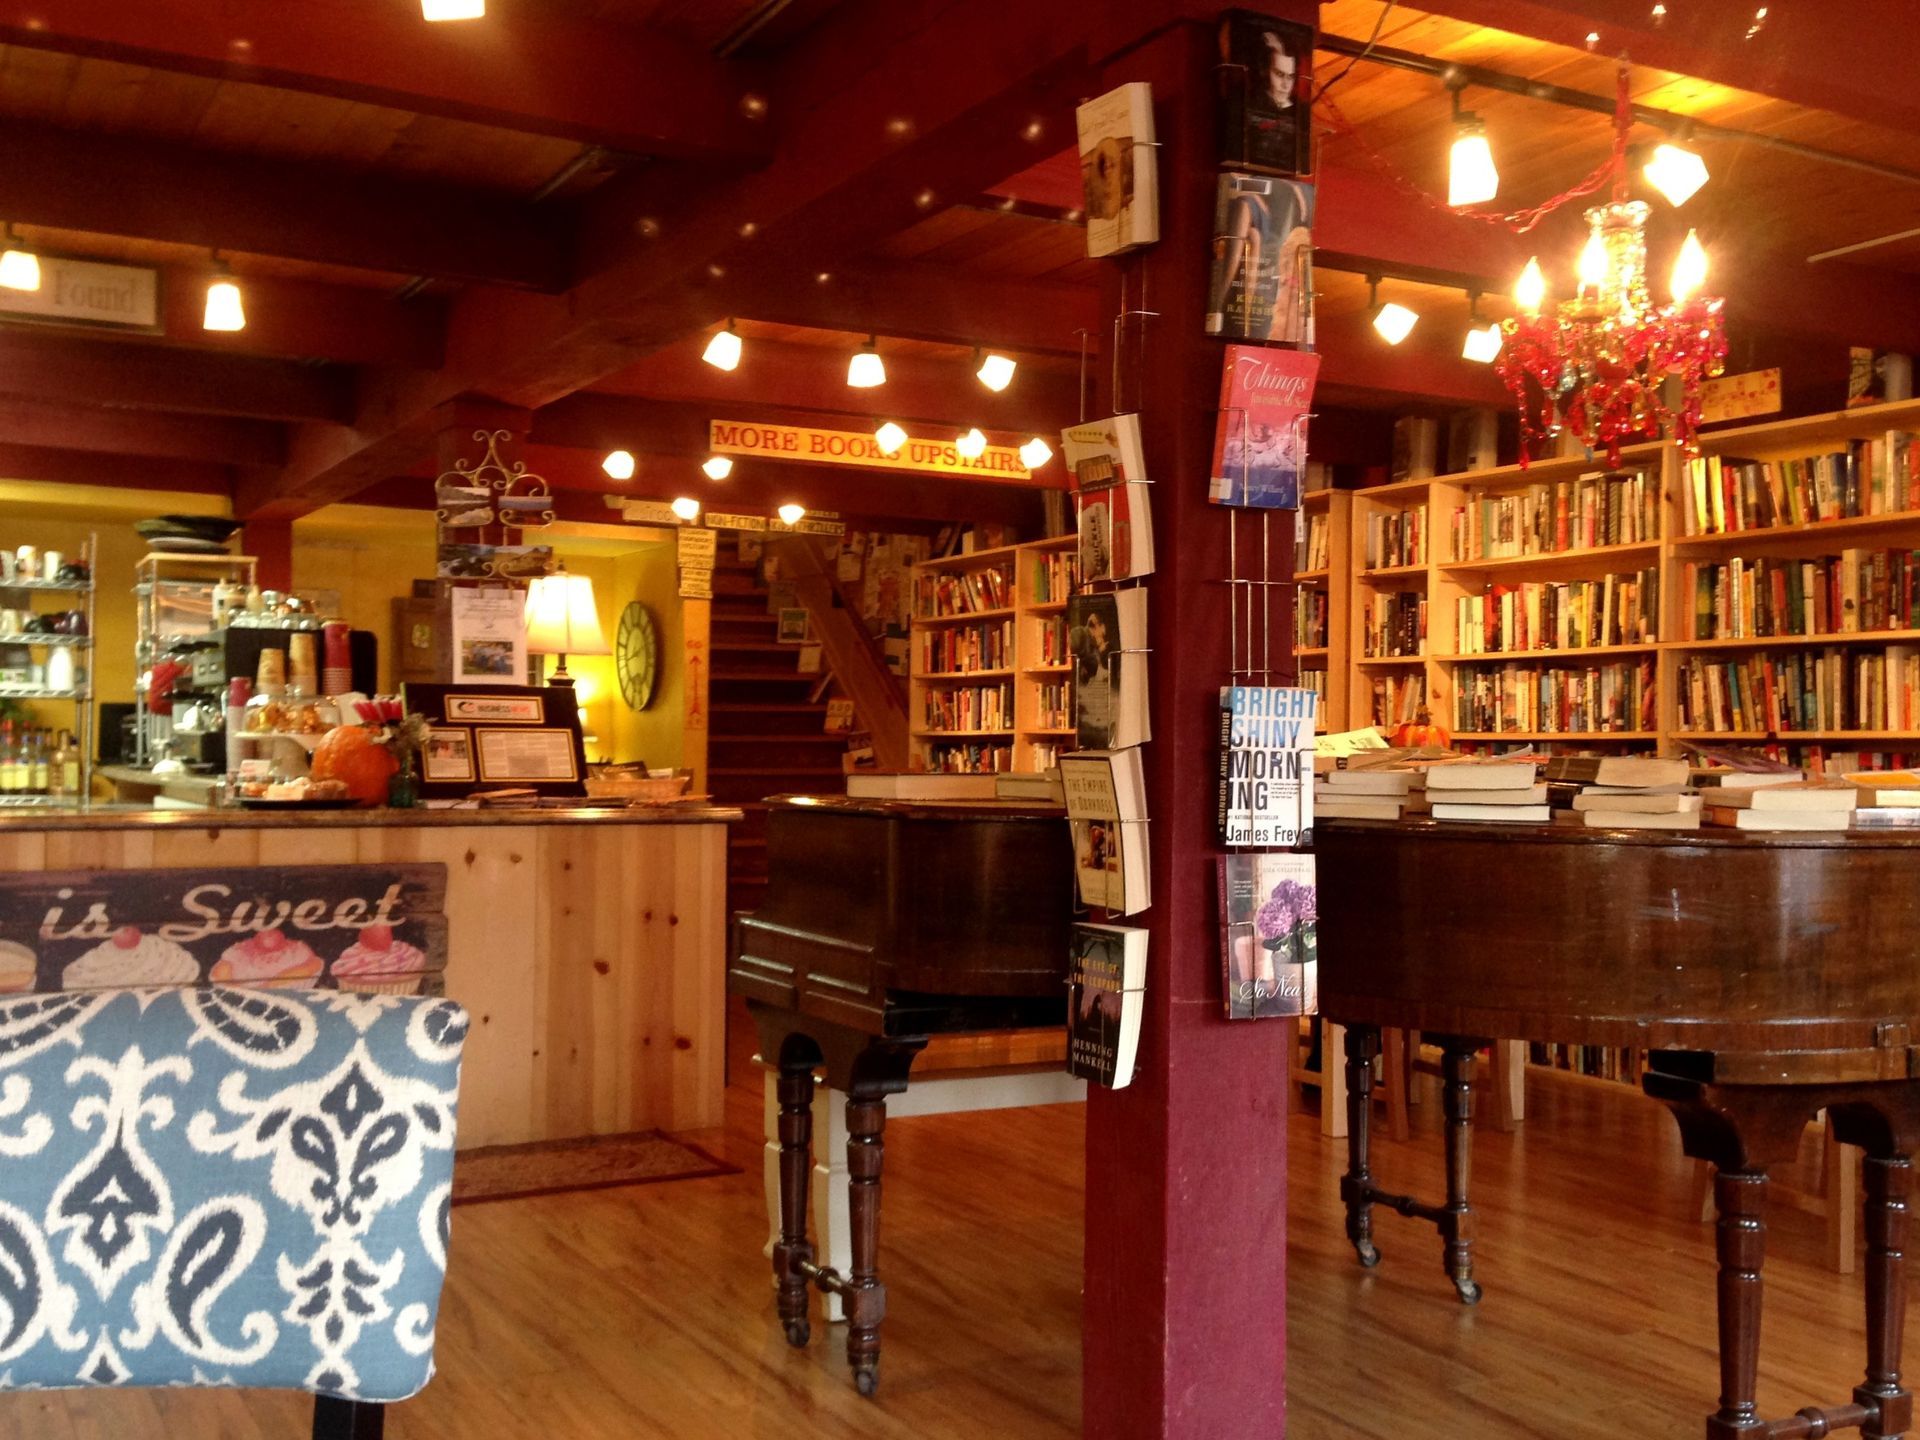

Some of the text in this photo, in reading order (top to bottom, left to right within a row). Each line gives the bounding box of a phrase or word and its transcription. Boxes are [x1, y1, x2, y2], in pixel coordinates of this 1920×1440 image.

[1238, 356, 1306, 402] Things
[713, 425, 798, 452] MORE
[809, 434, 900, 461] BOOKS
[1231, 687, 1318, 718] BRIGHT
[1221, 712, 1231, 746] BRIGHT
[1231, 719, 1300, 748] SHINY
[1229, 750, 1300, 780] MORN
[1067, 777, 1108, 794] THE EMPIRE
[1228, 781, 1268, 811] ING
[1078, 796, 1114, 814] DARKNESS
[1218, 780, 1228, 825] MORNING
[1226, 825, 1269, 842] James
[1274, 826, 1300, 847] Frey
[40, 884, 407, 943] is Sweet
[1074, 972, 1086, 985] THE
[1239, 976, 1265, 1003] So
[1072, 1052, 1112, 1072] MANKELL
[1073, 1038, 1113, 1058] HENNING
